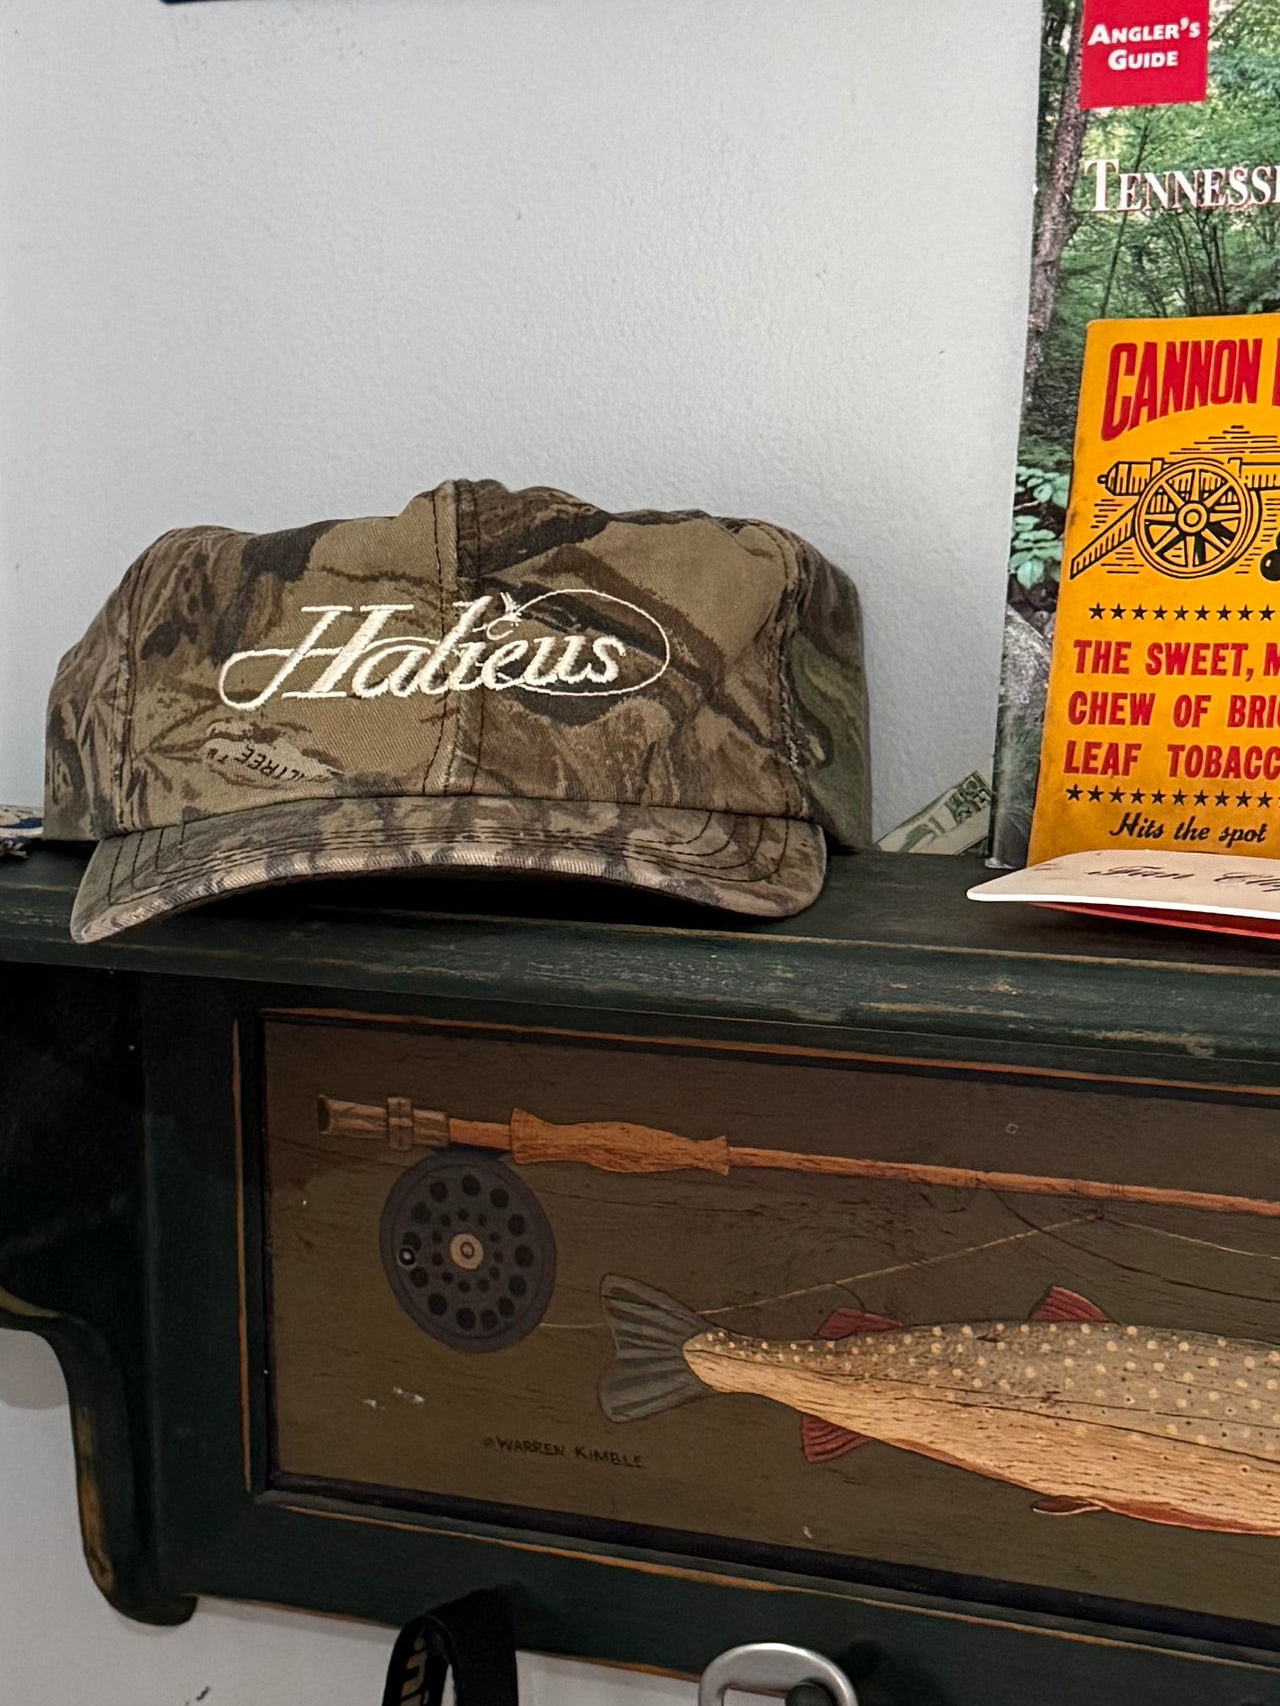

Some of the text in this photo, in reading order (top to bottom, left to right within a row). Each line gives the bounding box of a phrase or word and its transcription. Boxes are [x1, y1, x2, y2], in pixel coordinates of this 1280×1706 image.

[1101, 338, 1263, 441] CANNON
[1074, 641, 1130, 675] THE
[1146, 642, 1255, 681] SWEET,
[1068, 691, 1155, 726] CHEW
[1173, 695, 1211, 728] OF
[1064, 741, 1141, 774] LEAF
[1109, 812, 1267, 848] Hits the spot
[496, 1436, 644, 1468] WARREN KIMBLE
